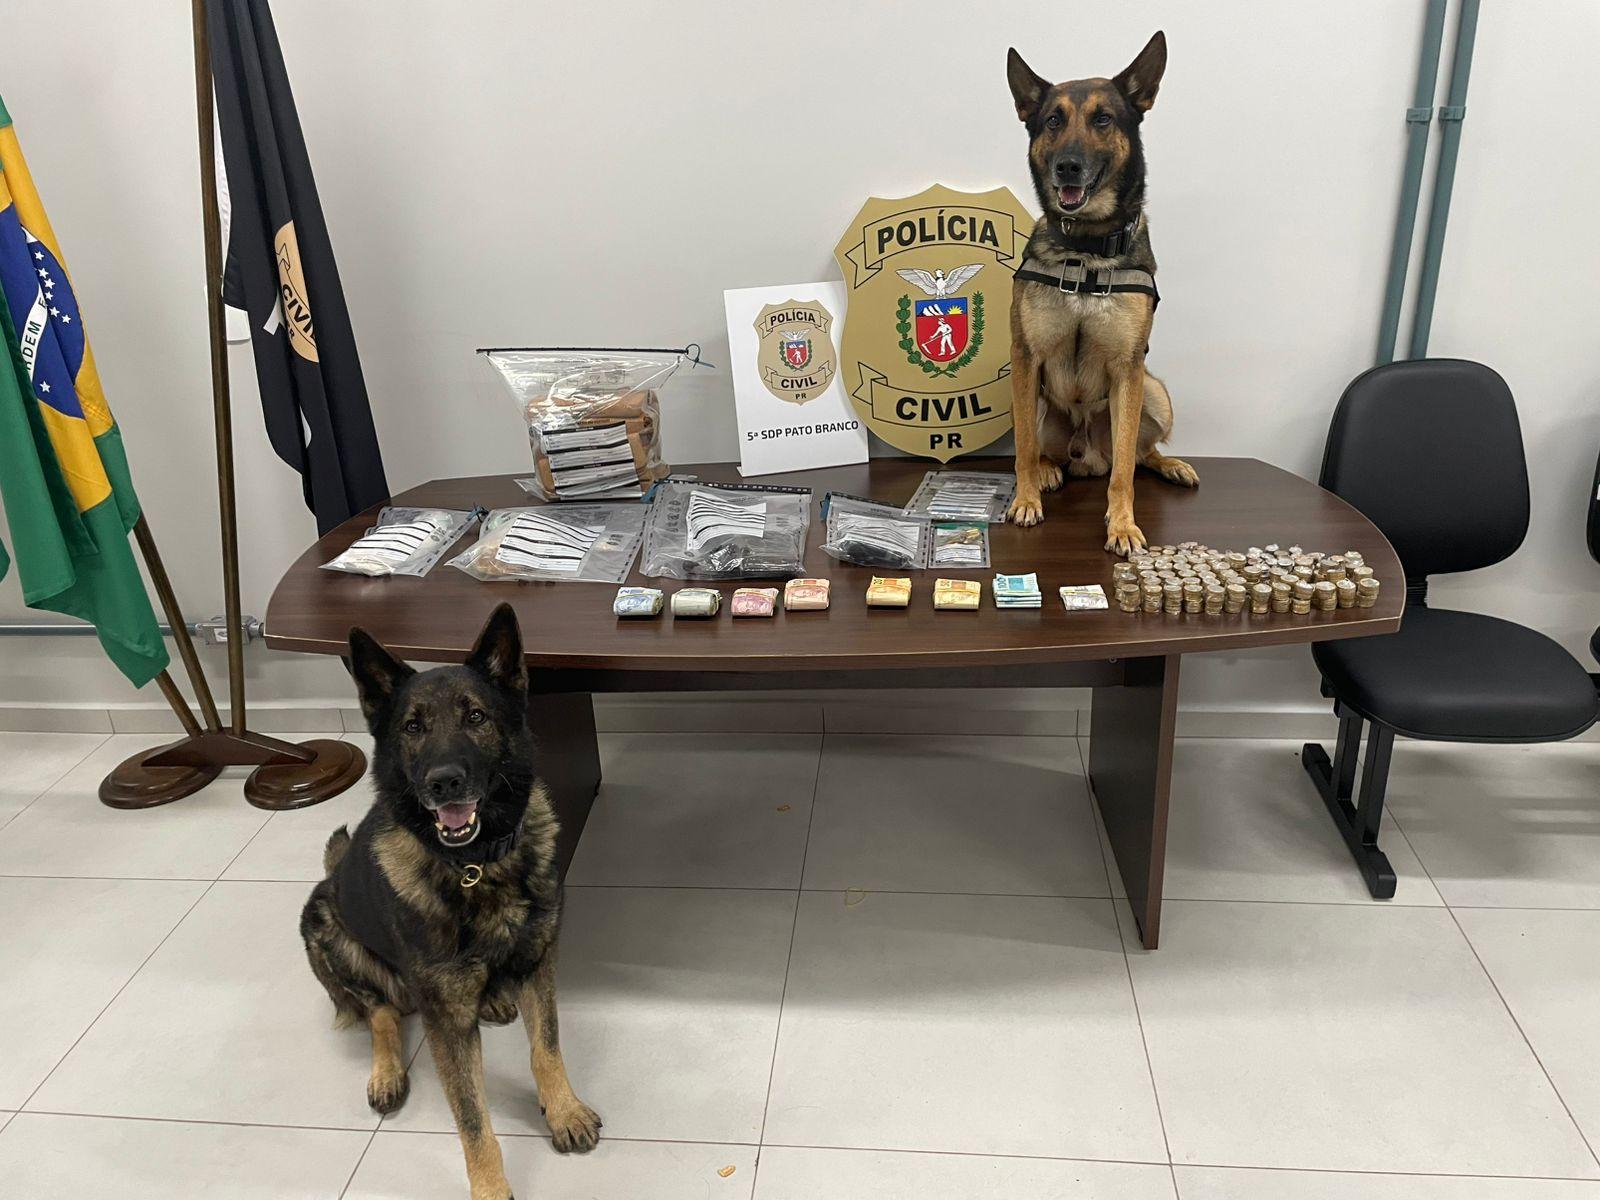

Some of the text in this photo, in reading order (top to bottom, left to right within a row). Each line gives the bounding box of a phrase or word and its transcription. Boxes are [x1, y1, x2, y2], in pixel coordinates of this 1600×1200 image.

[877, 209, 1000, 255] POLÍCIA
[282, 284, 315, 339] CIVI
[770, 309, 816, 326] POLÍCIA
[22, 320, 42, 371] DEM
[781, 376, 817, 389] CIVIL
[896, 393, 992, 422] CIVIL
[747, 420, 859, 441] 5ª SDP PATO BRANCO
[930, 433, 963, 450] PR
